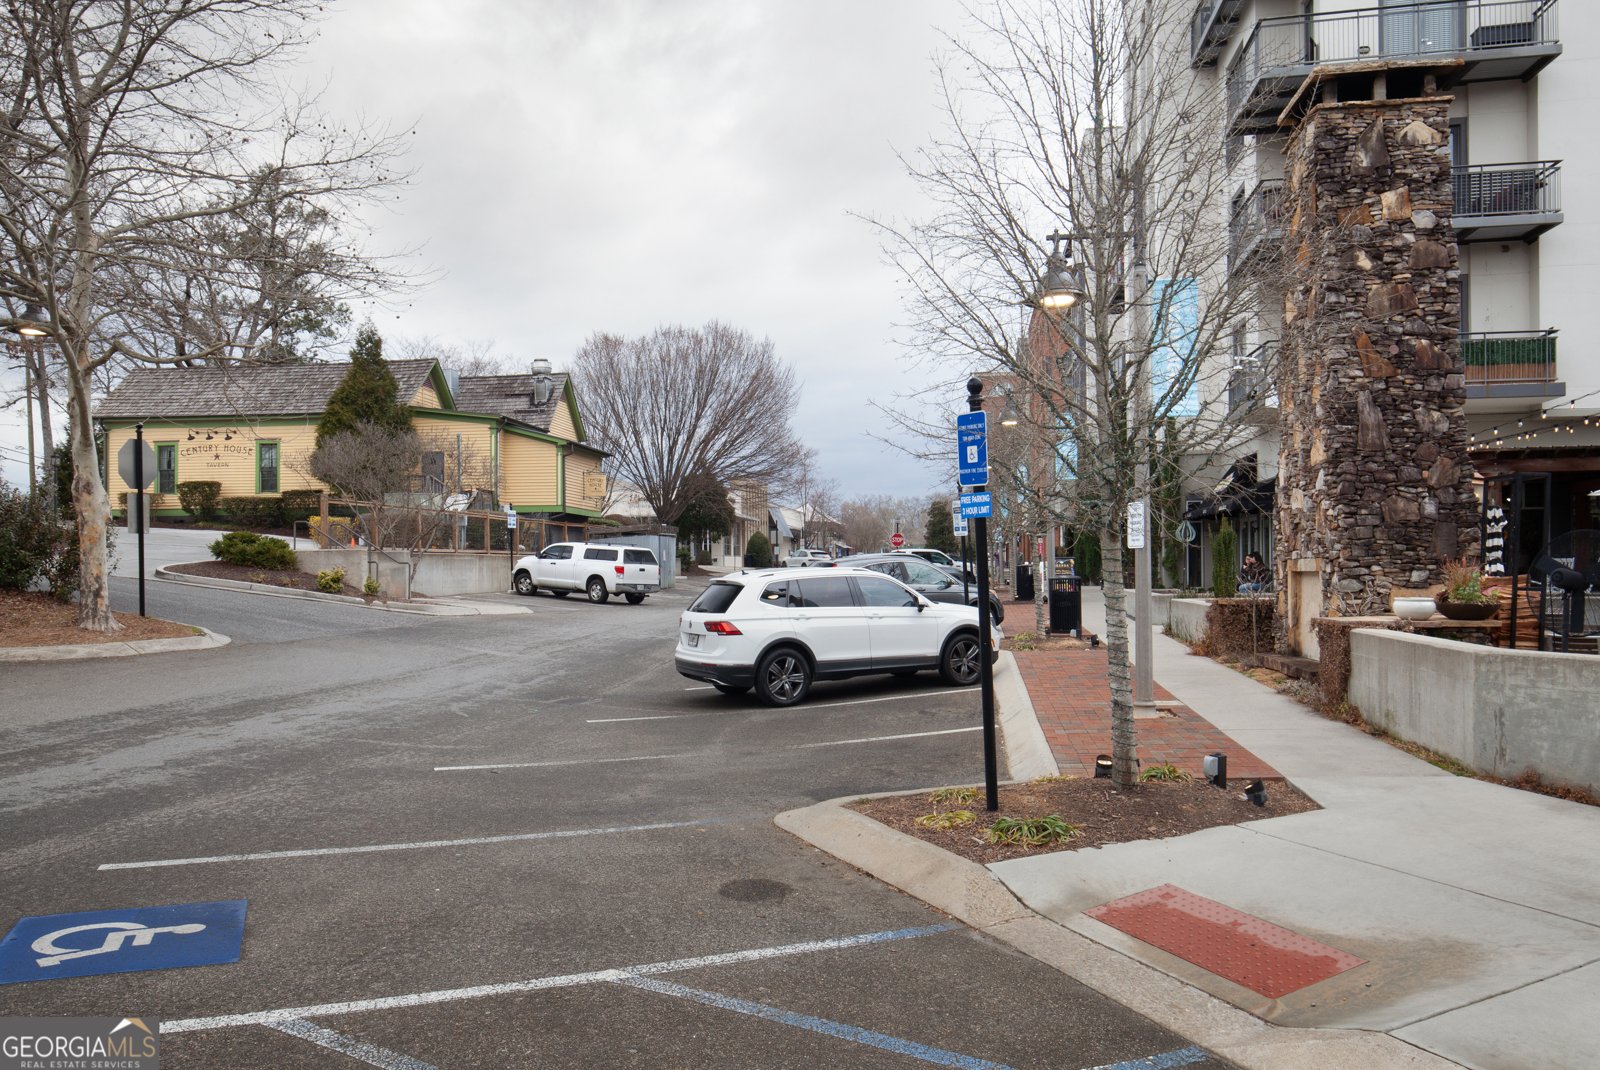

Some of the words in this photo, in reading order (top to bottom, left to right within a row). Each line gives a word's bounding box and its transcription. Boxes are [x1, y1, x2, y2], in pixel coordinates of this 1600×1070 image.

[180, 444, 219, 457] CENTURY
[223, 444, 253, 456] HOUSE
[960, 496, 971, 504] FREE
[971, 494, 990, 503] PARKING
[965, 506, 978, 515] HOUR
[978, 505, 990, 514] LIMIT
